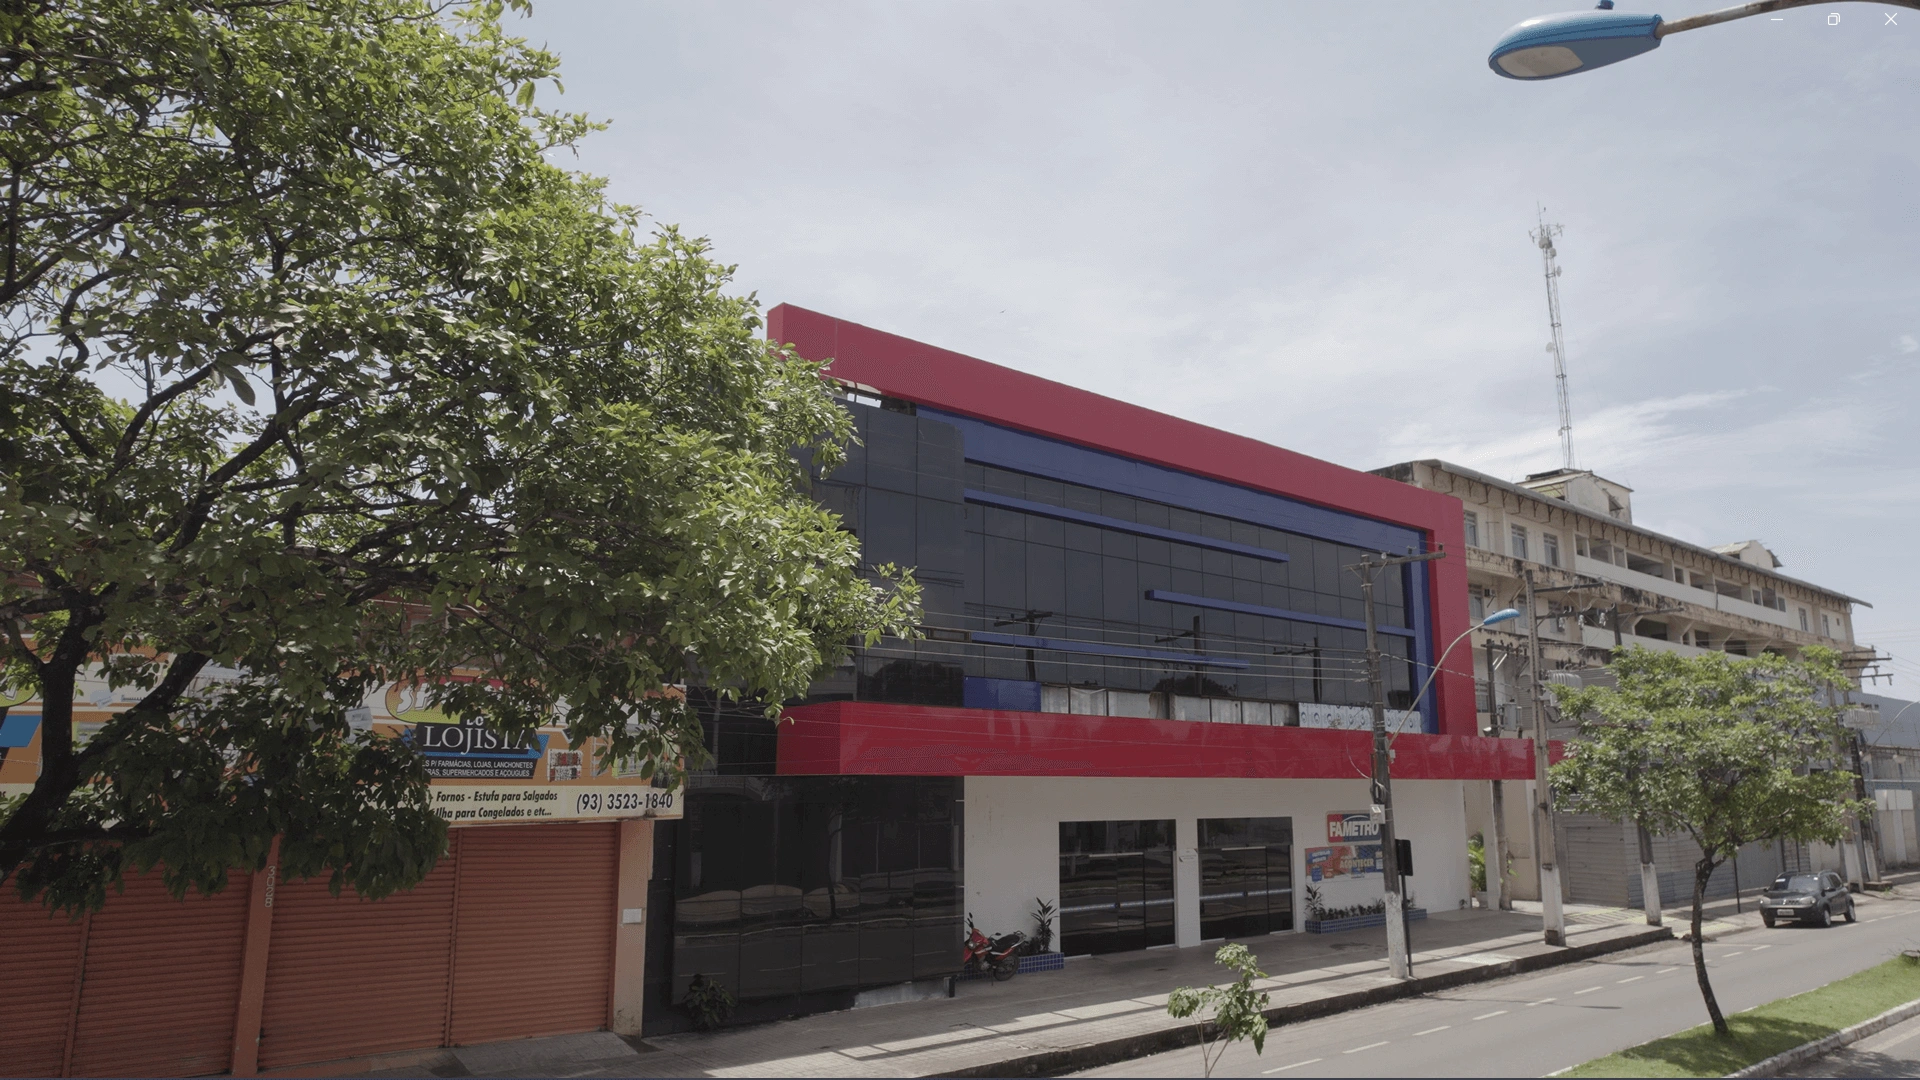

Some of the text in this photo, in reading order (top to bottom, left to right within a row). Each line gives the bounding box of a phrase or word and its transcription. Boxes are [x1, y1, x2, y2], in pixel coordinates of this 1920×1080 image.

[493, 761, 534, 769] LANCHONETES
[442, 768, 494, 777] SUPERMERCADOS
[500, 769, 530, 778] AÇOUGUES
[436, 791, 465, 802] Fornos
[474, 790, 500, 802] Estufa
[501, 793, 521, 804] para
[522, 790, 558, 803] Salgados
[576, 792, 673, 814] (93) 3523-1840
[454, 809, 476, 820] para
[478, 805, 525, 820] Congelados
[526, 808, 532, 816] e
[533, 807, 552, 816] etc...
[1329, 820, 1380, 837] FAMETRO
[264, 865, 276, 908] 3028
